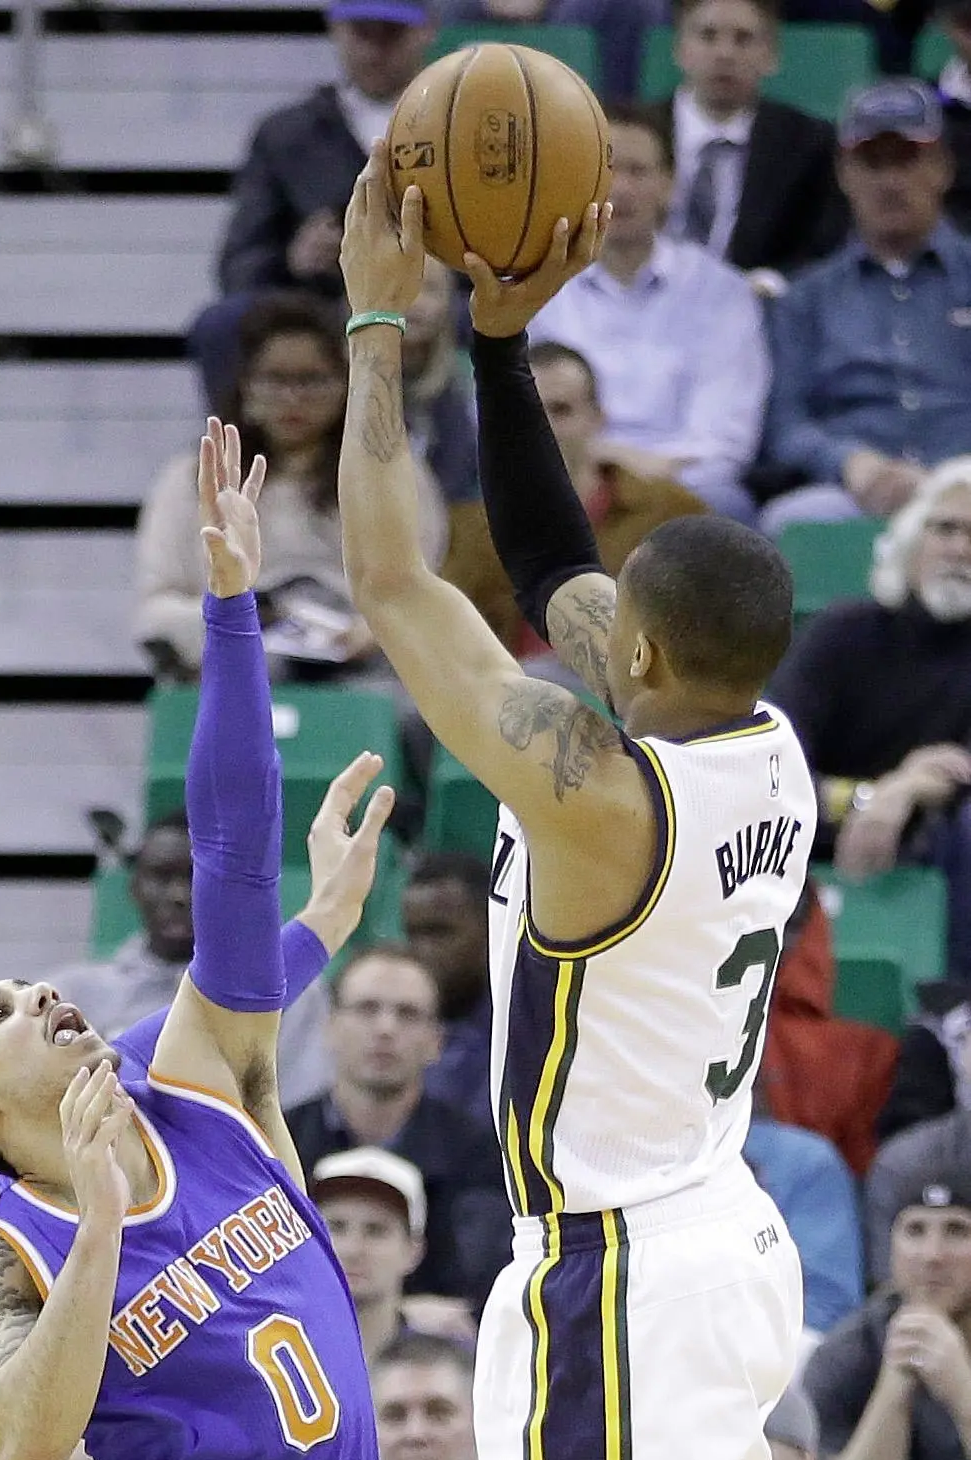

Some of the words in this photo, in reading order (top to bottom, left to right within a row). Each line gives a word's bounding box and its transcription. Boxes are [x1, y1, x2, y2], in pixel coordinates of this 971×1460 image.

[715, 815, 802, 900] BURKE
[703, 926, 780, 1108] 3
[108, 1257, 222, 1378] NEW
[187, 1183, 313, 1295] YORK
[245, 1312, 341, 1452] 0
